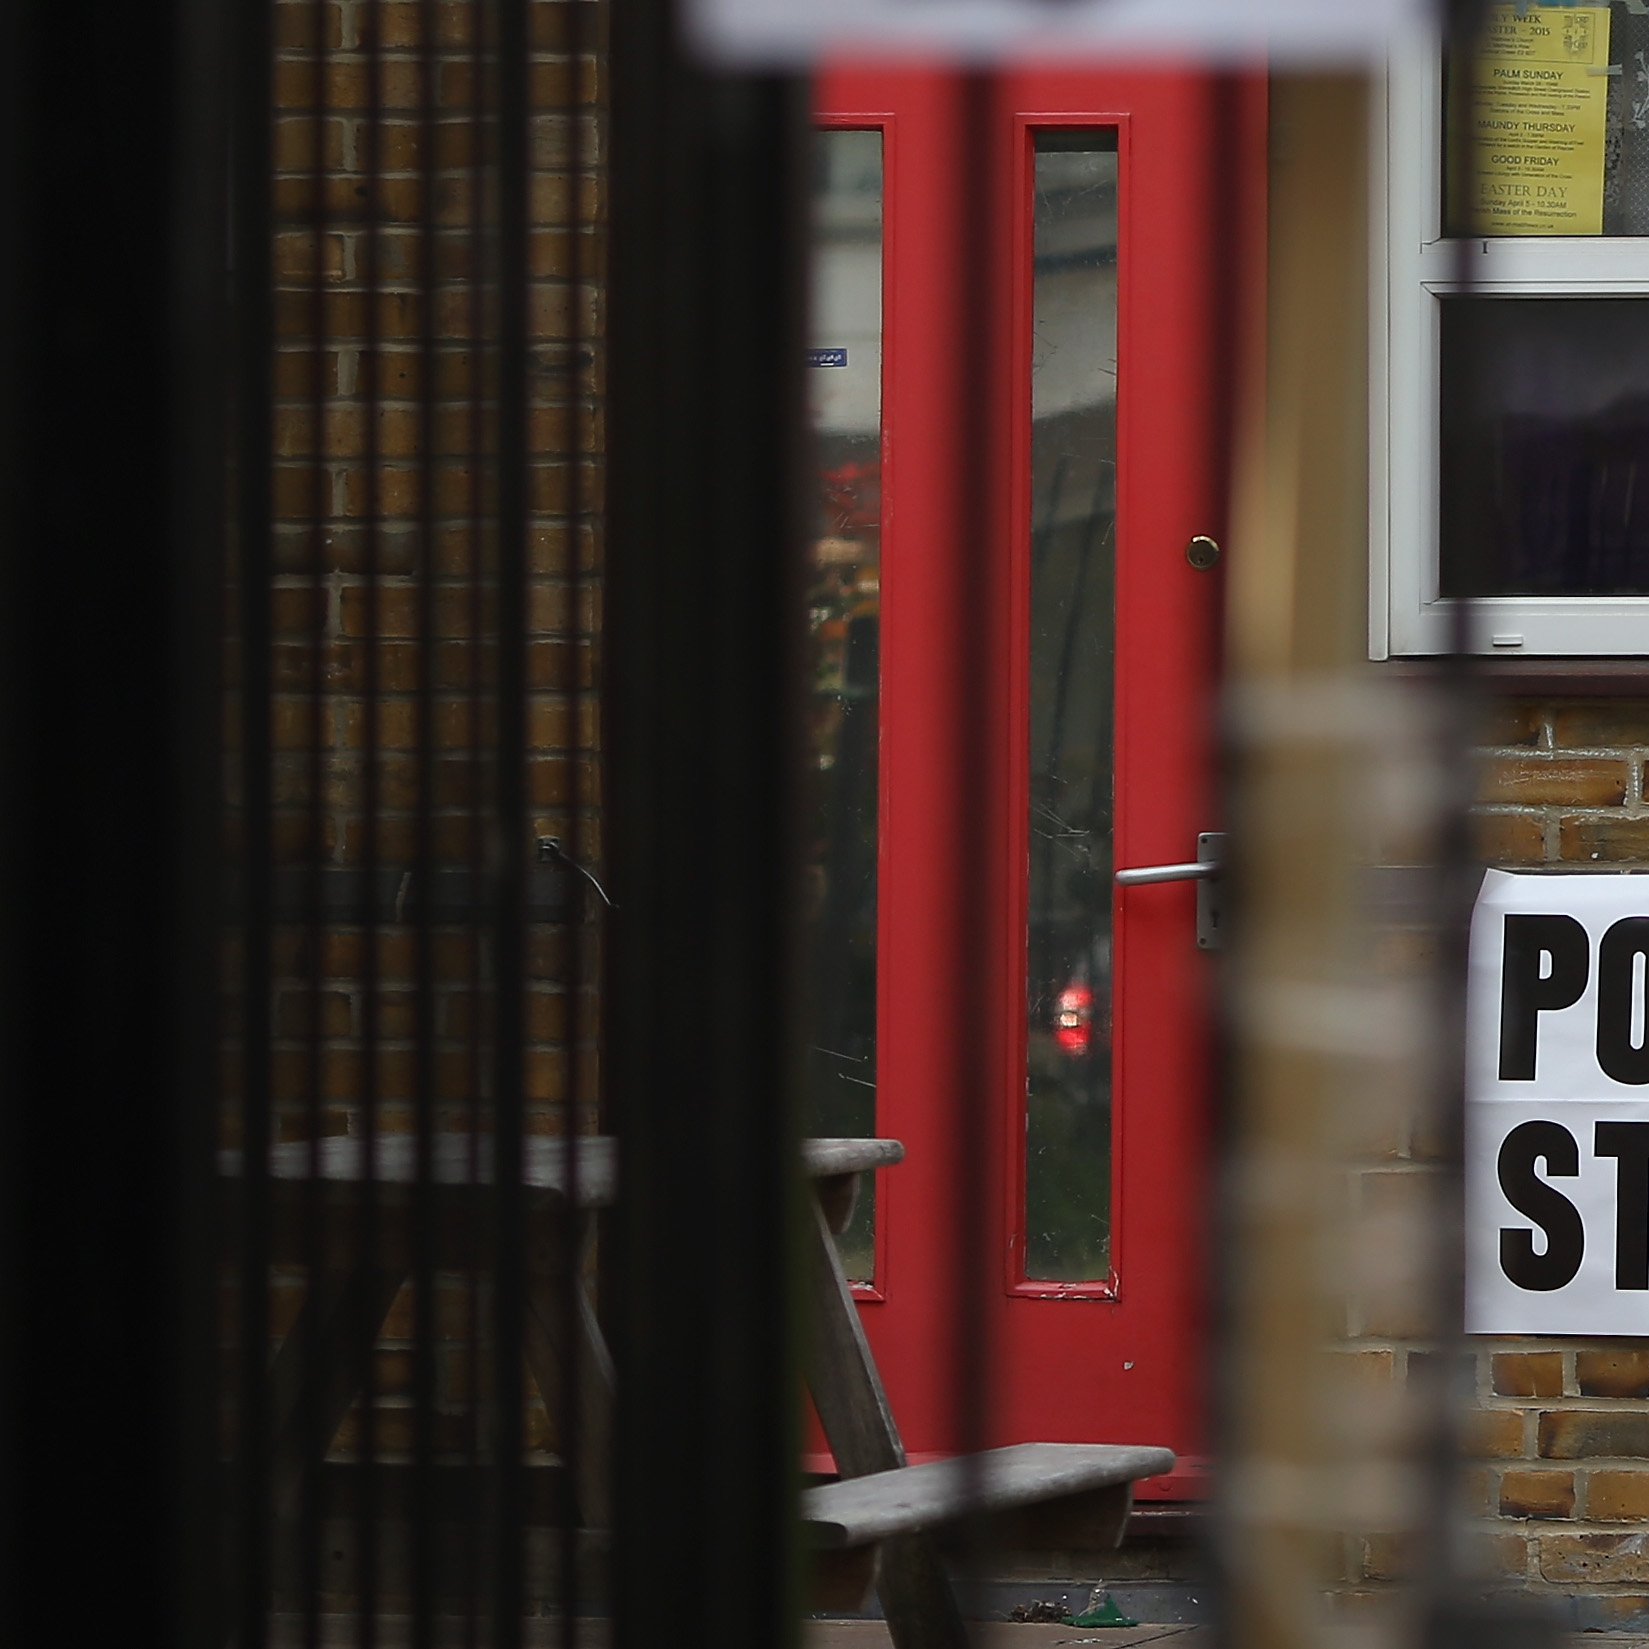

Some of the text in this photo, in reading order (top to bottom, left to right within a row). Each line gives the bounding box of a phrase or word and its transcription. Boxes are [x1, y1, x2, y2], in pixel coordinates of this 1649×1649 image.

[1529, 26, 1551, 37] 2015
[1493, 69, 1564, 80] PALM SUNDAY
[1478, 120, 1576, 132] MAUNDY THURSDAY
[1491, 155, 1560, 166] GOOD FRIDAY
[1481, 183, 1568, 198] EASTER DAY
